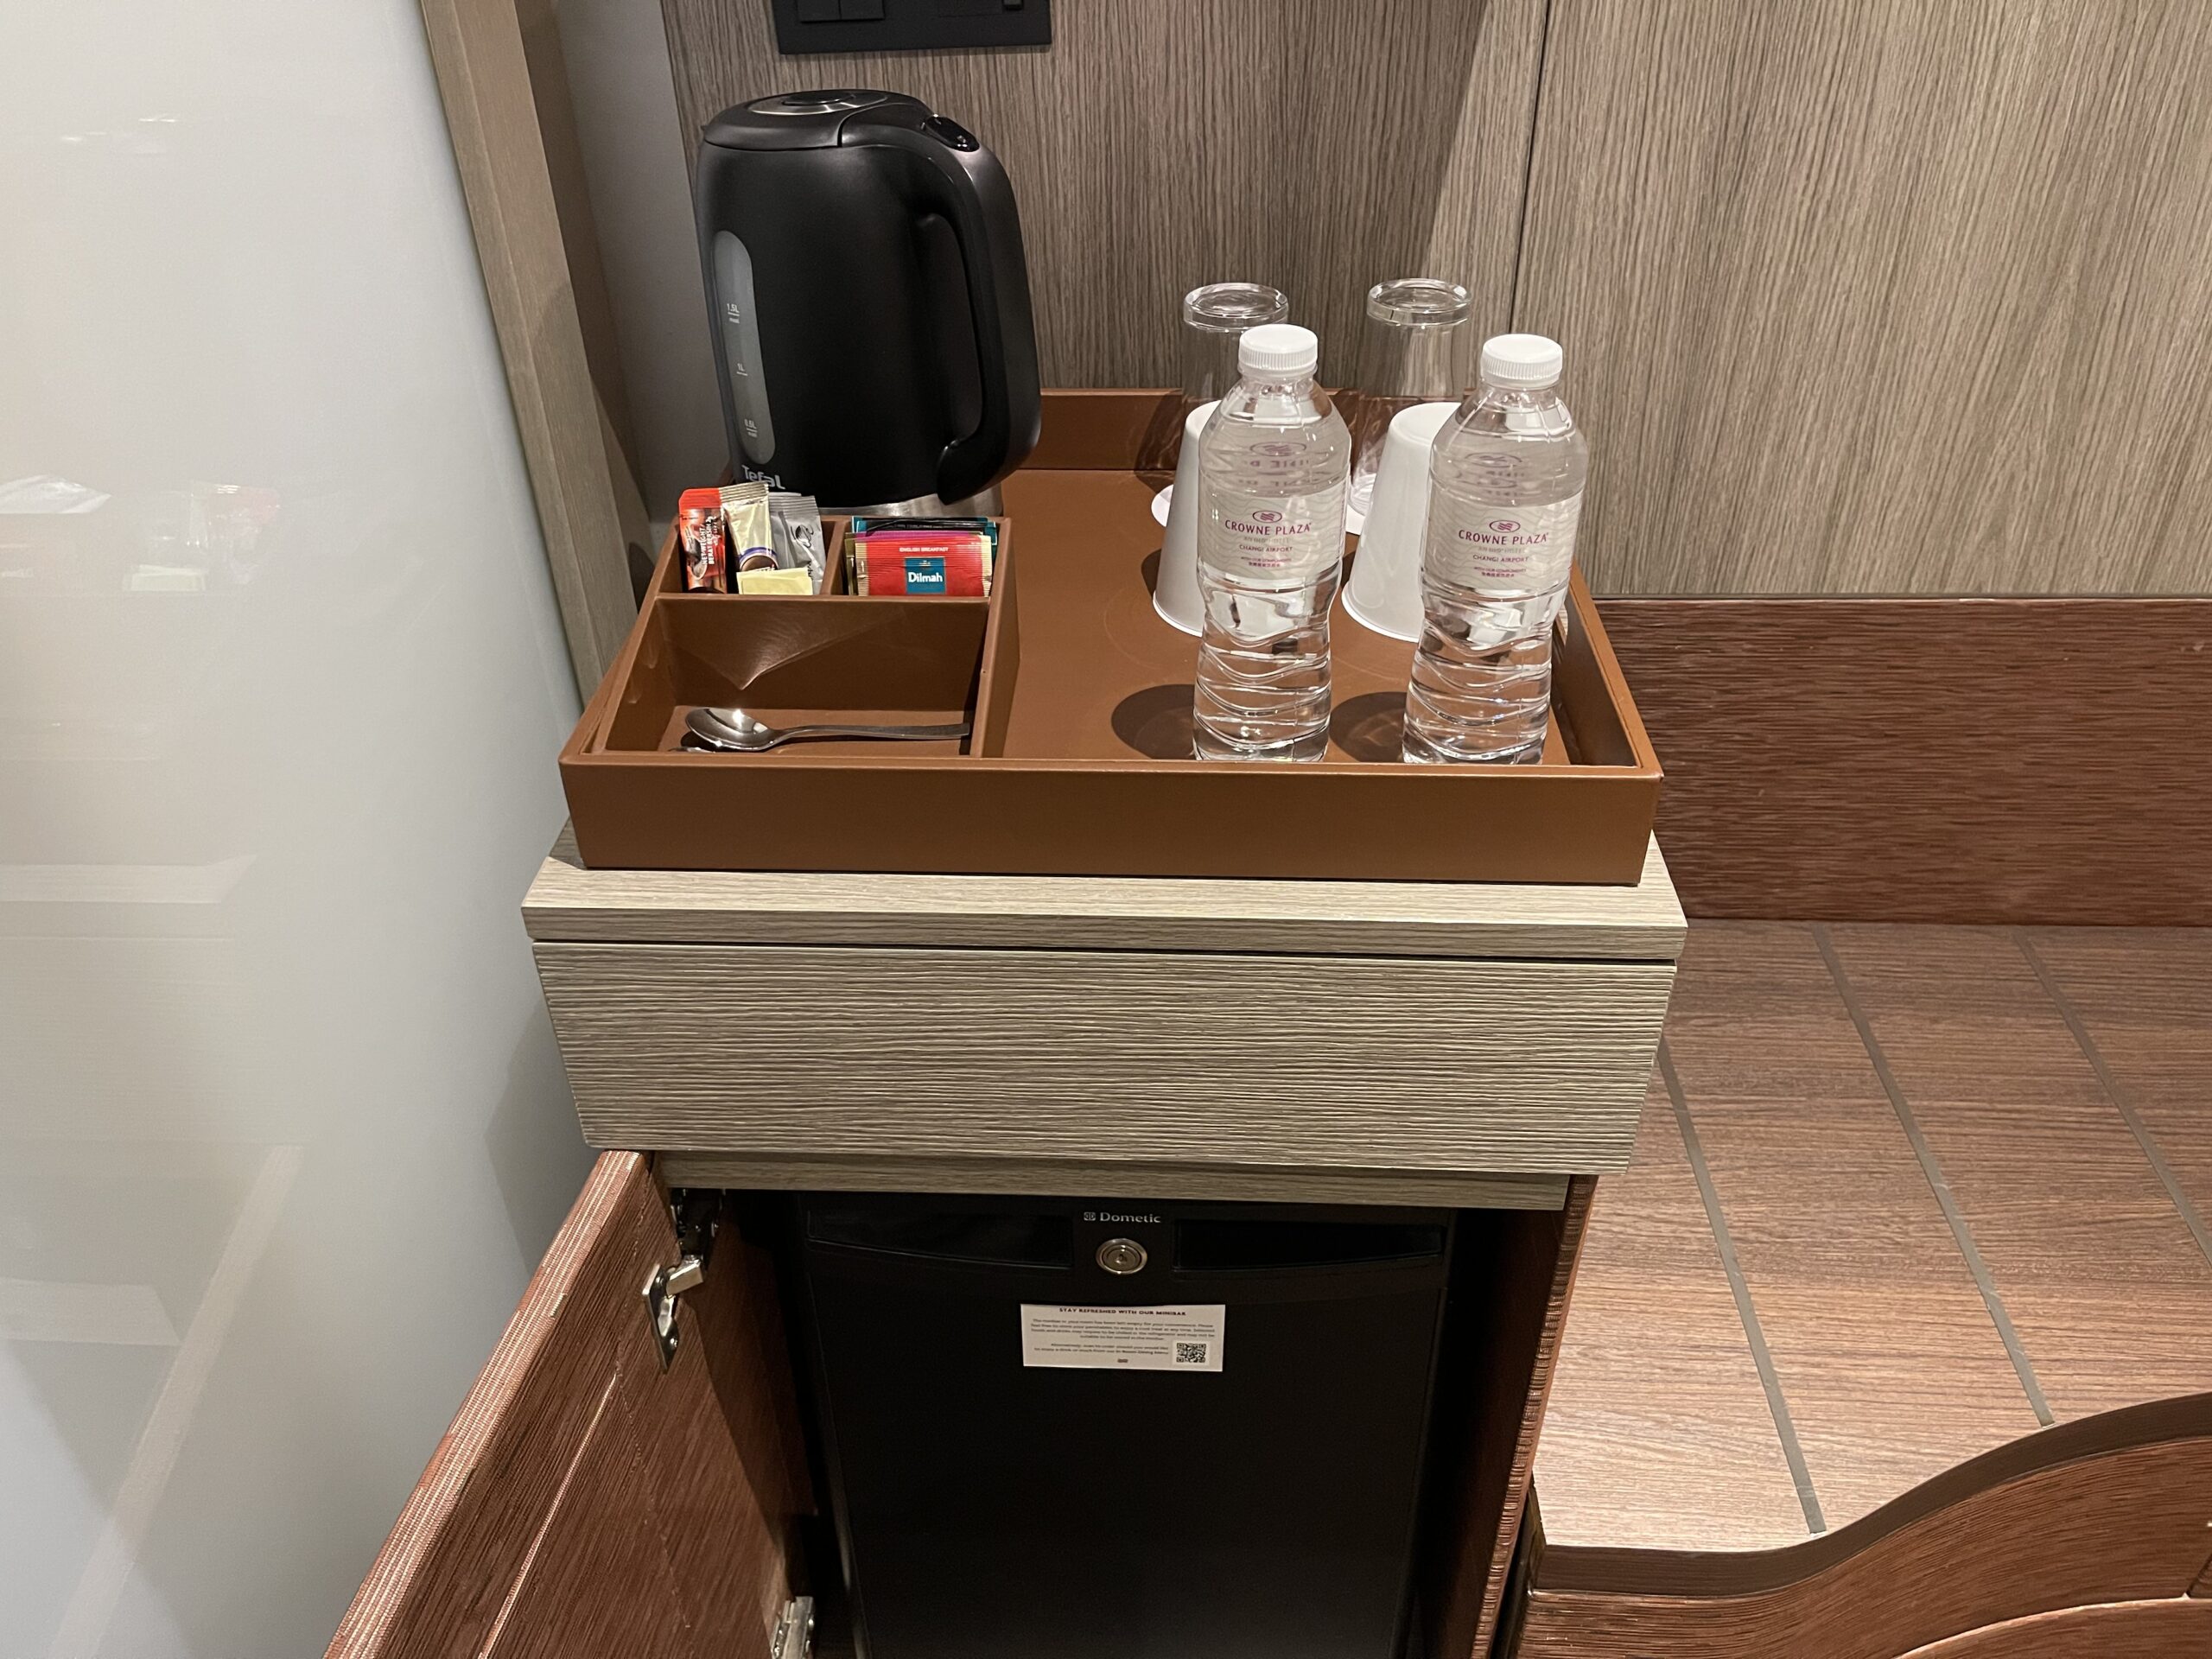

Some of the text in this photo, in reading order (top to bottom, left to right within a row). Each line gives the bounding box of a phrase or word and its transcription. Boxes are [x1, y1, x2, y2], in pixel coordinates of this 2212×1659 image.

[741, 465, 786, 490] Tefal
[1225, 520, 1311, 536] CROWNE PLAZA
[1459, 530, 1547, 545] CROWNE PLAZA
[1239, 544, 1264, 553] CHANGI
[907, 571, 944, 582] Dilmah
[1100, 1212, 1161, 1223] Dometic
